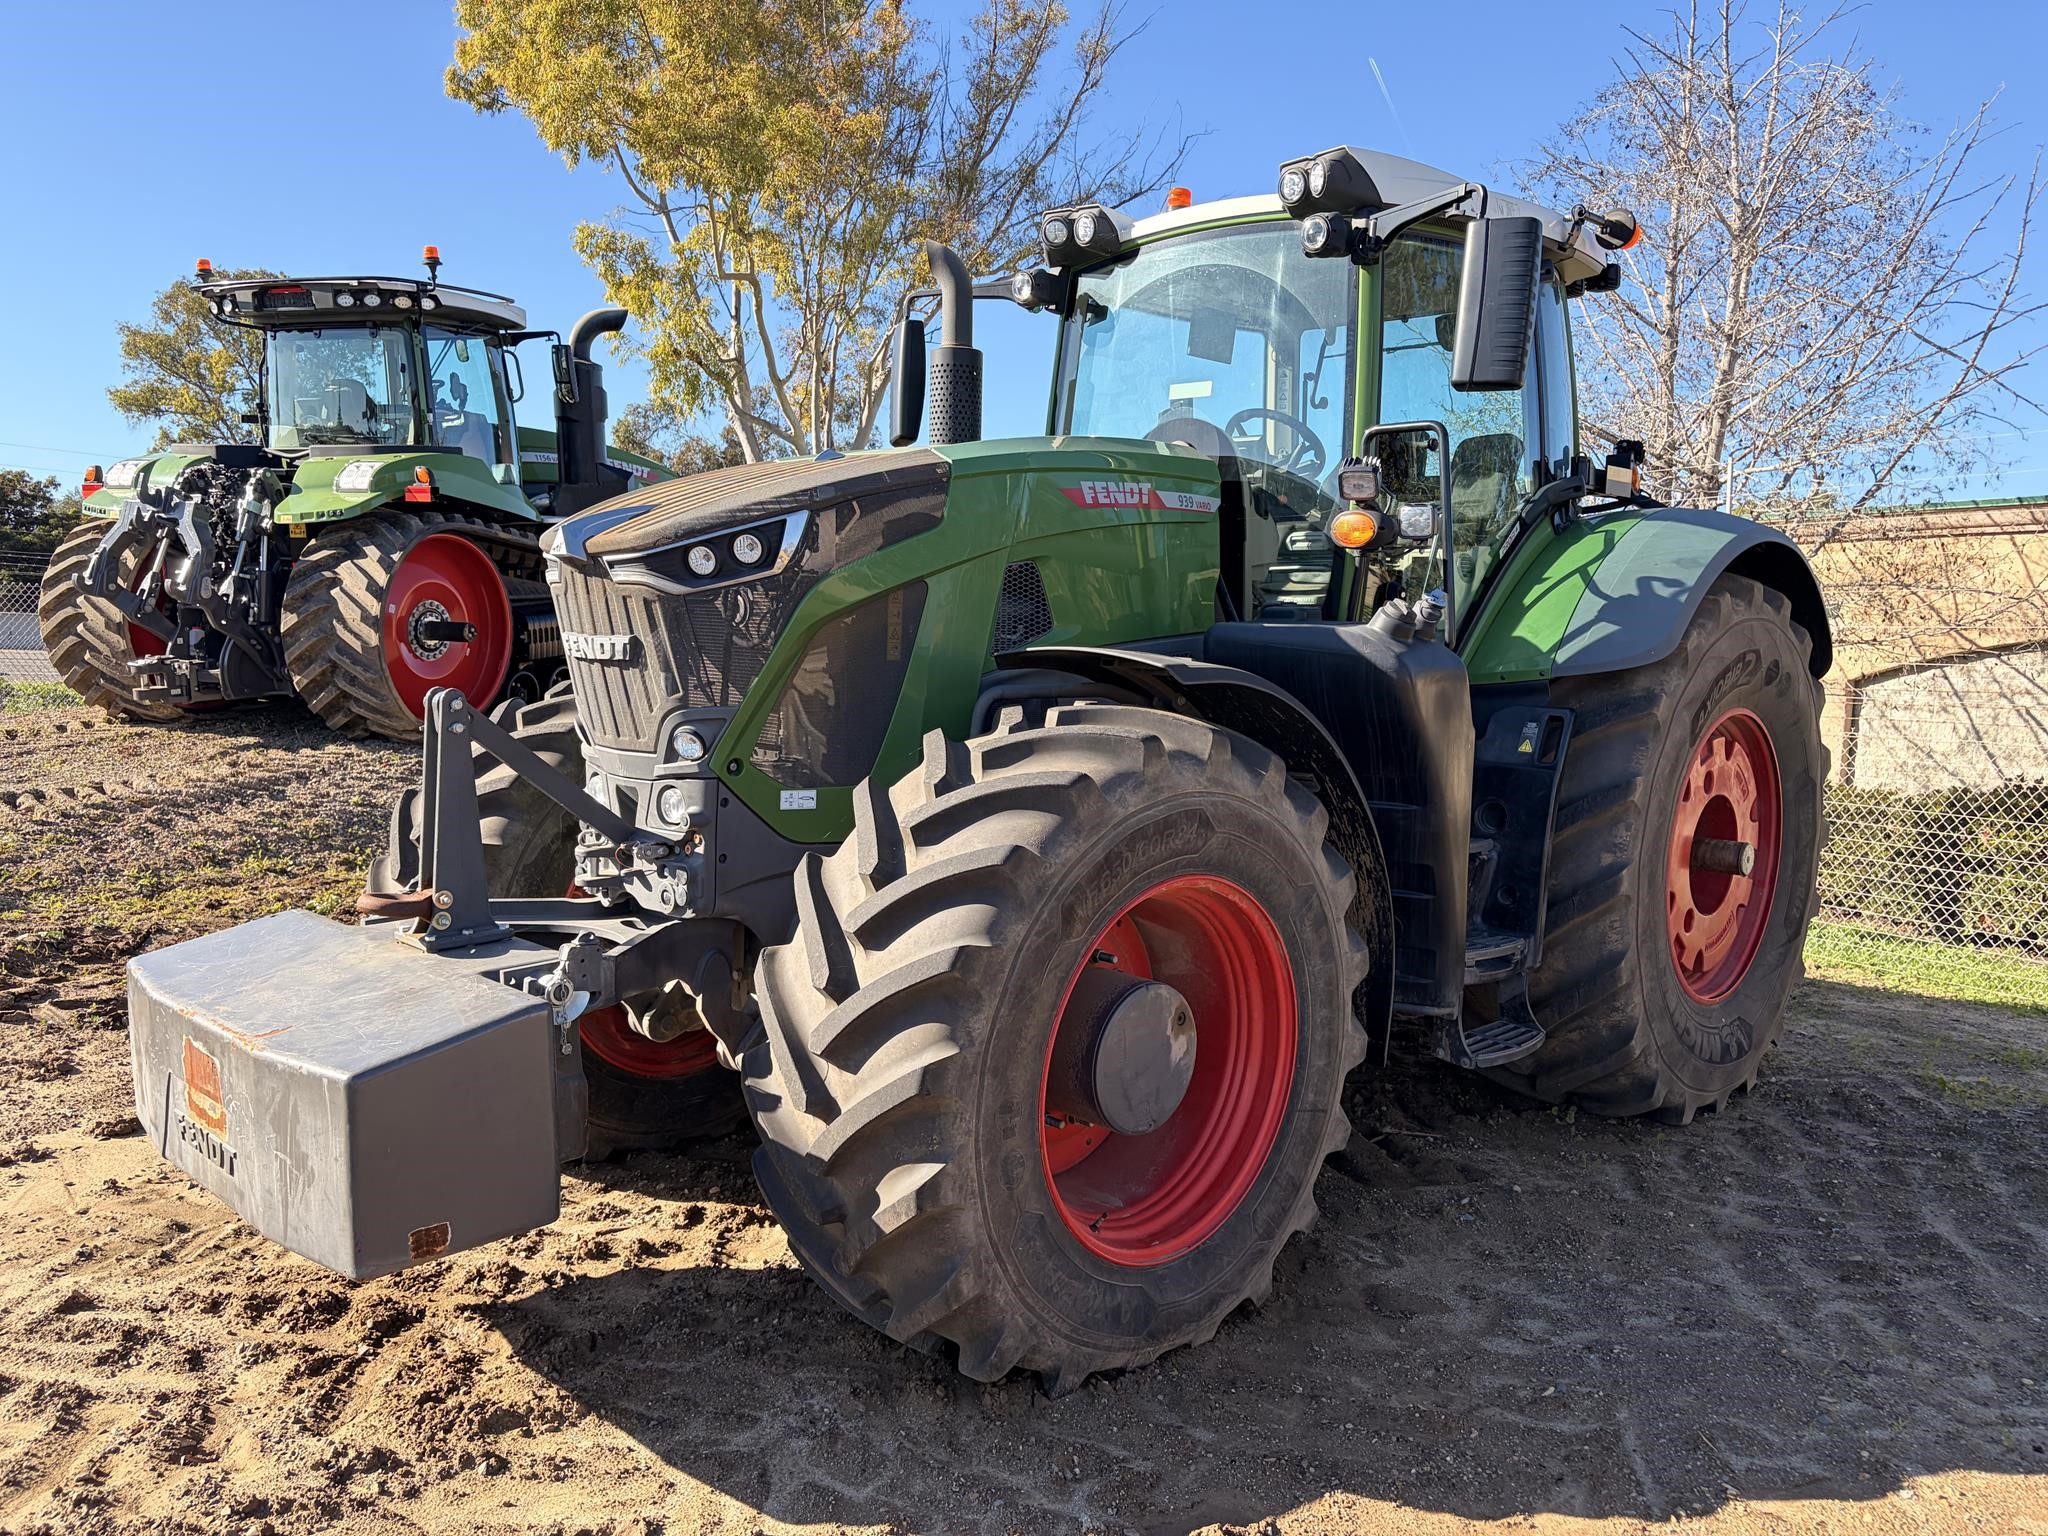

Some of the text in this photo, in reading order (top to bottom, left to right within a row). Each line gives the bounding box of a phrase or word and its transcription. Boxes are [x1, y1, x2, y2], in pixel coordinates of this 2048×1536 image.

[535, 453, 552, 463] 1156
[1080, 481, 1152, 505] FENDT
[1178, 494, 1212, 511] 939 VARIO
[562, 632, 631, 661] FENDT
[174, 1109, 238, 1178] FENDT
